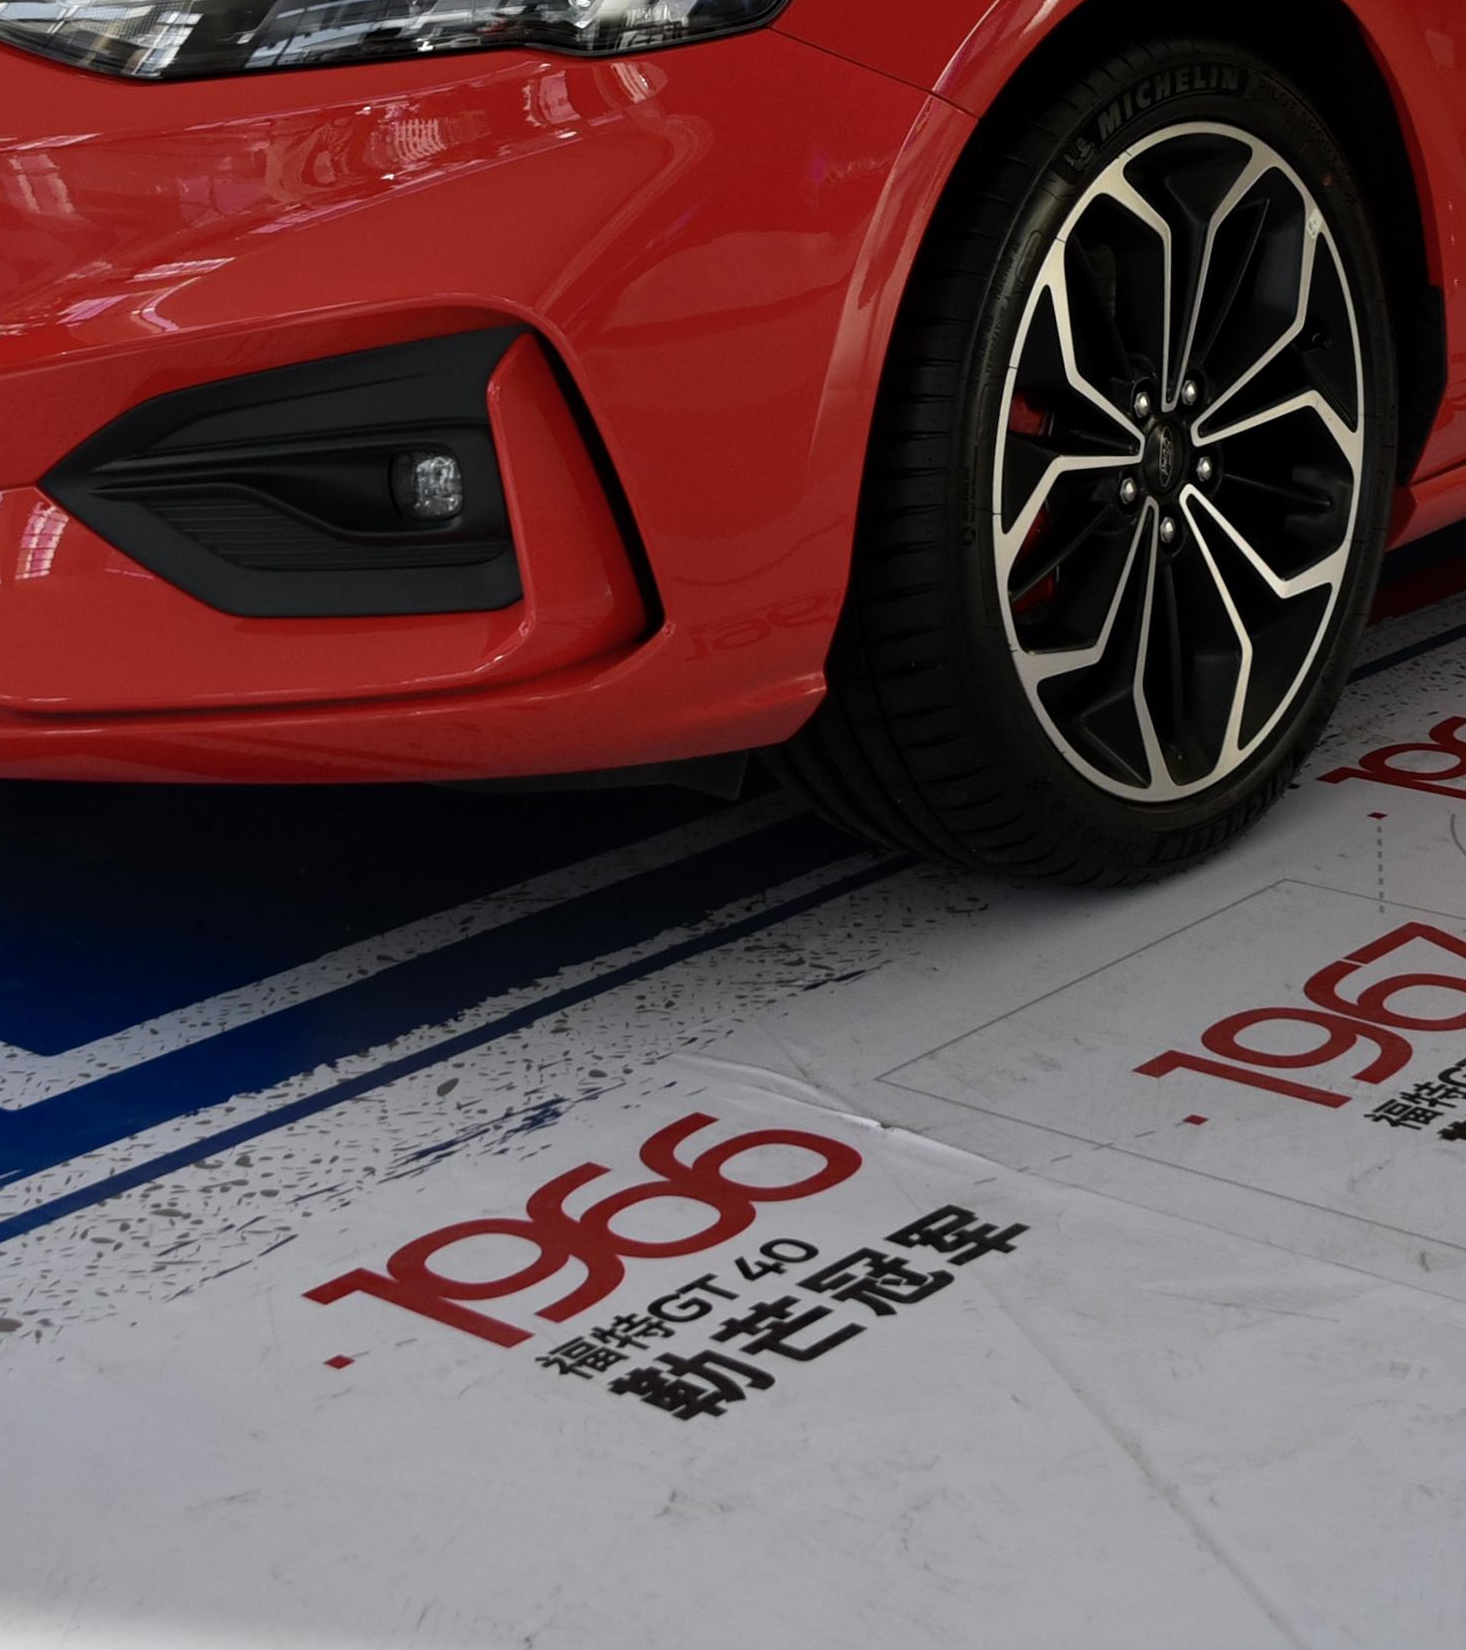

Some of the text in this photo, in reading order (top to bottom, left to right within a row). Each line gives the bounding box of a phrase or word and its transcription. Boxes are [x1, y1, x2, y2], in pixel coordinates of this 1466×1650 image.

[1099, 65, 1239, 141] MICHELIN
[302, 1111, 863, 1348] 1966
[534, 1238, 820, 1379] 福特GT 40
[609, 1204, 1031, 1421] 勒芒冠军
